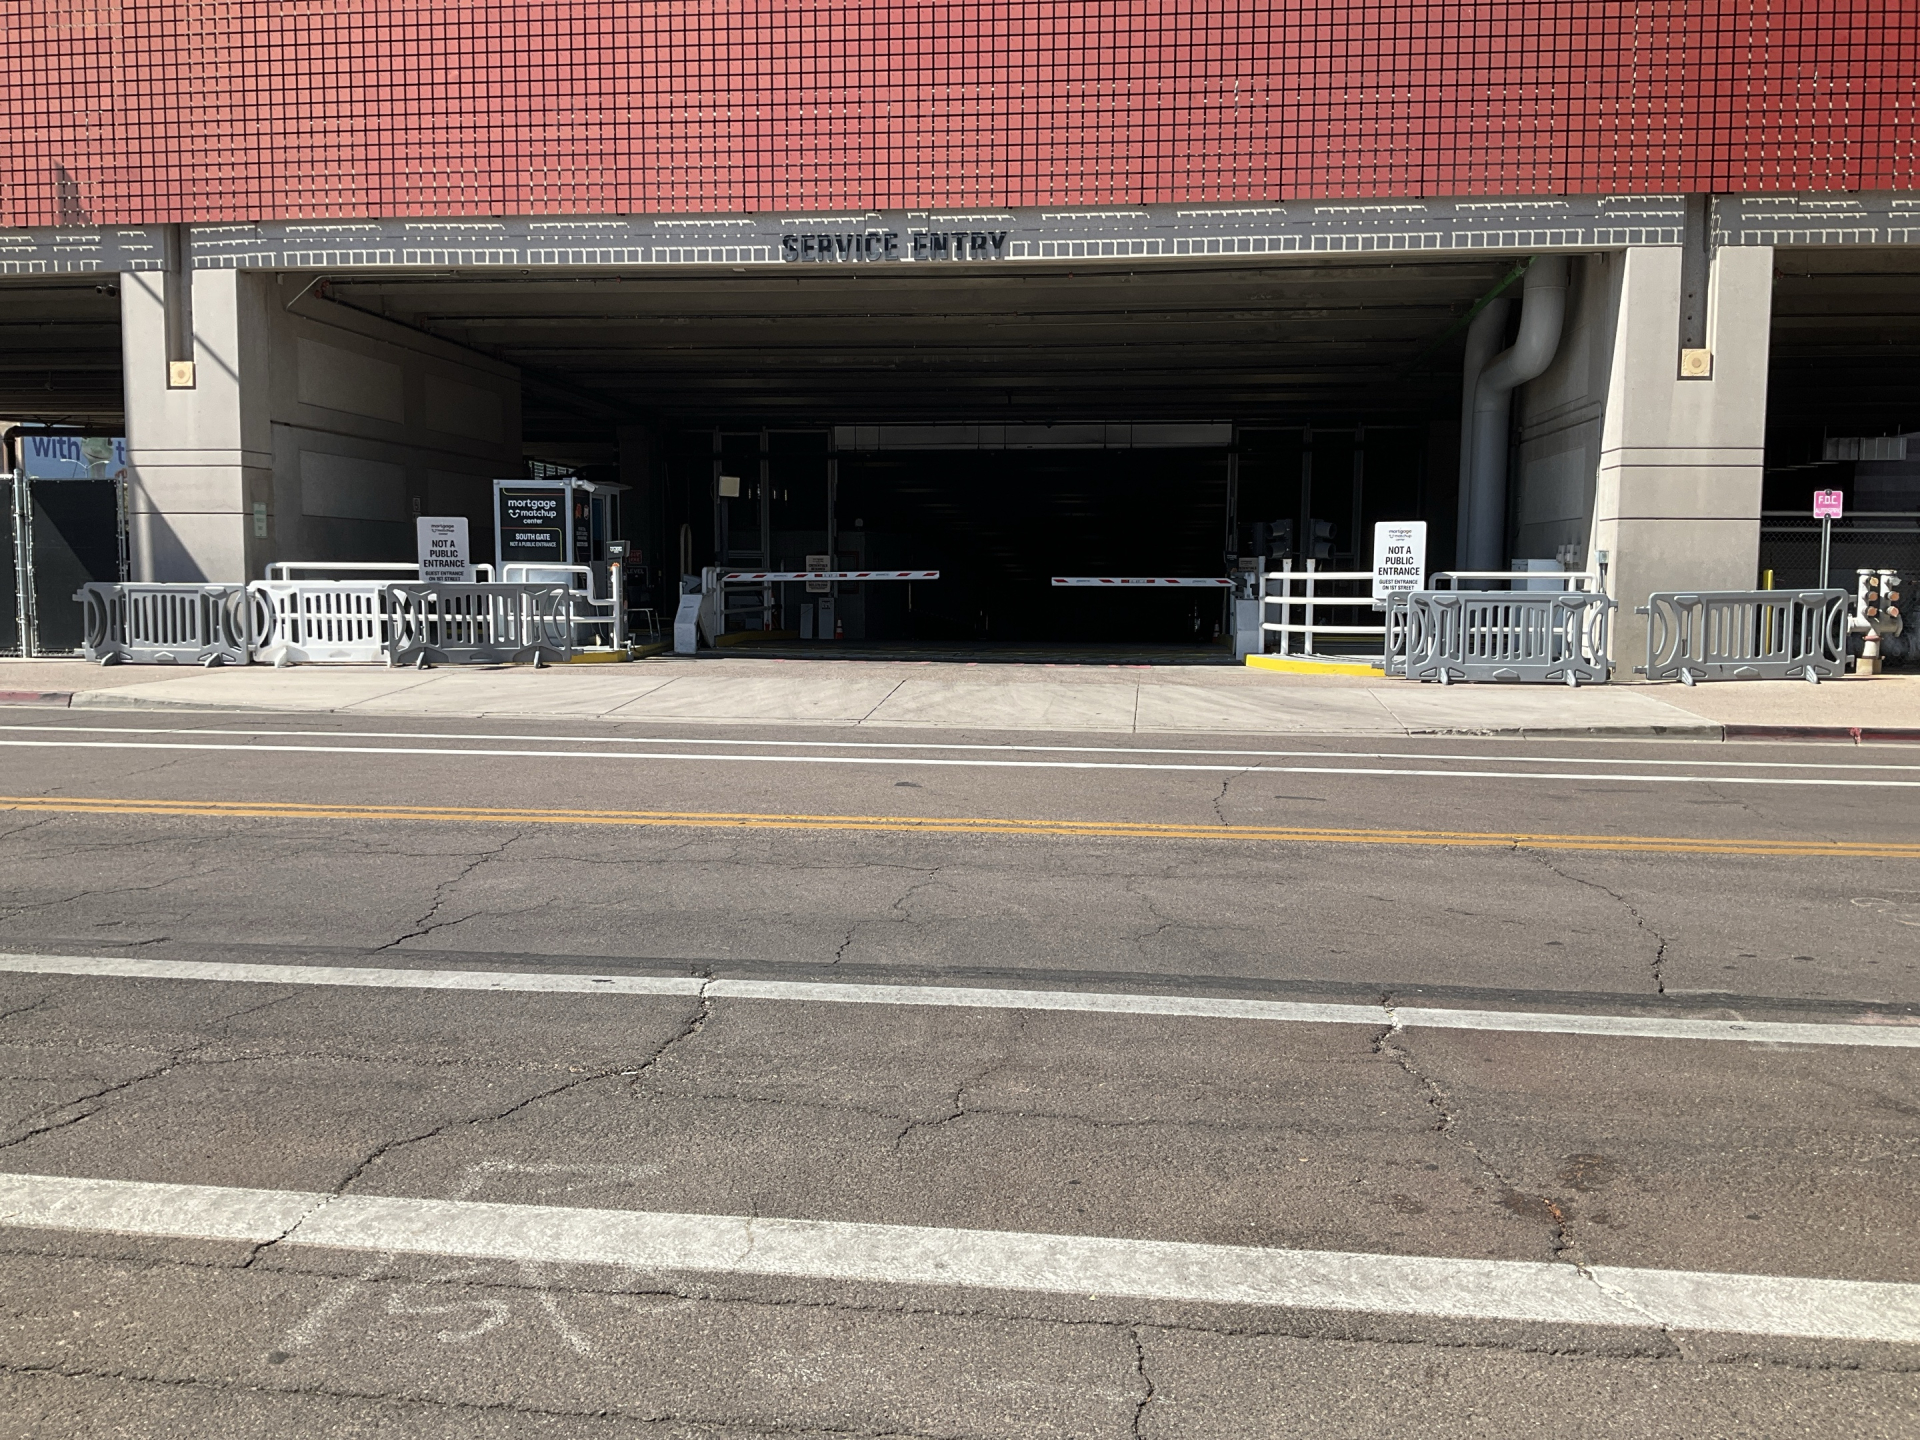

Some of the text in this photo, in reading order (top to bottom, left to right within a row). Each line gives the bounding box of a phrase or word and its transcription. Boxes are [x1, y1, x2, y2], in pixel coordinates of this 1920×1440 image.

[781, 231, 1008, 262] SERVICE ENTRY
[507, 499, 556, 509] mortgage
[520, 509, 556, 518] matchup
[536, 533, 551, 541] GATE
[431, 539, 456, 548] NOT A
[429, 549, 459, 558] PUBLIC
[1388, 545, 1412, 555] NOT A
[423, 559, 466, 568] ENTRANCE
[1385, 556, 1414, 565] PUBLIC
[1378, 566, 1420, 576] ENTRANCE
